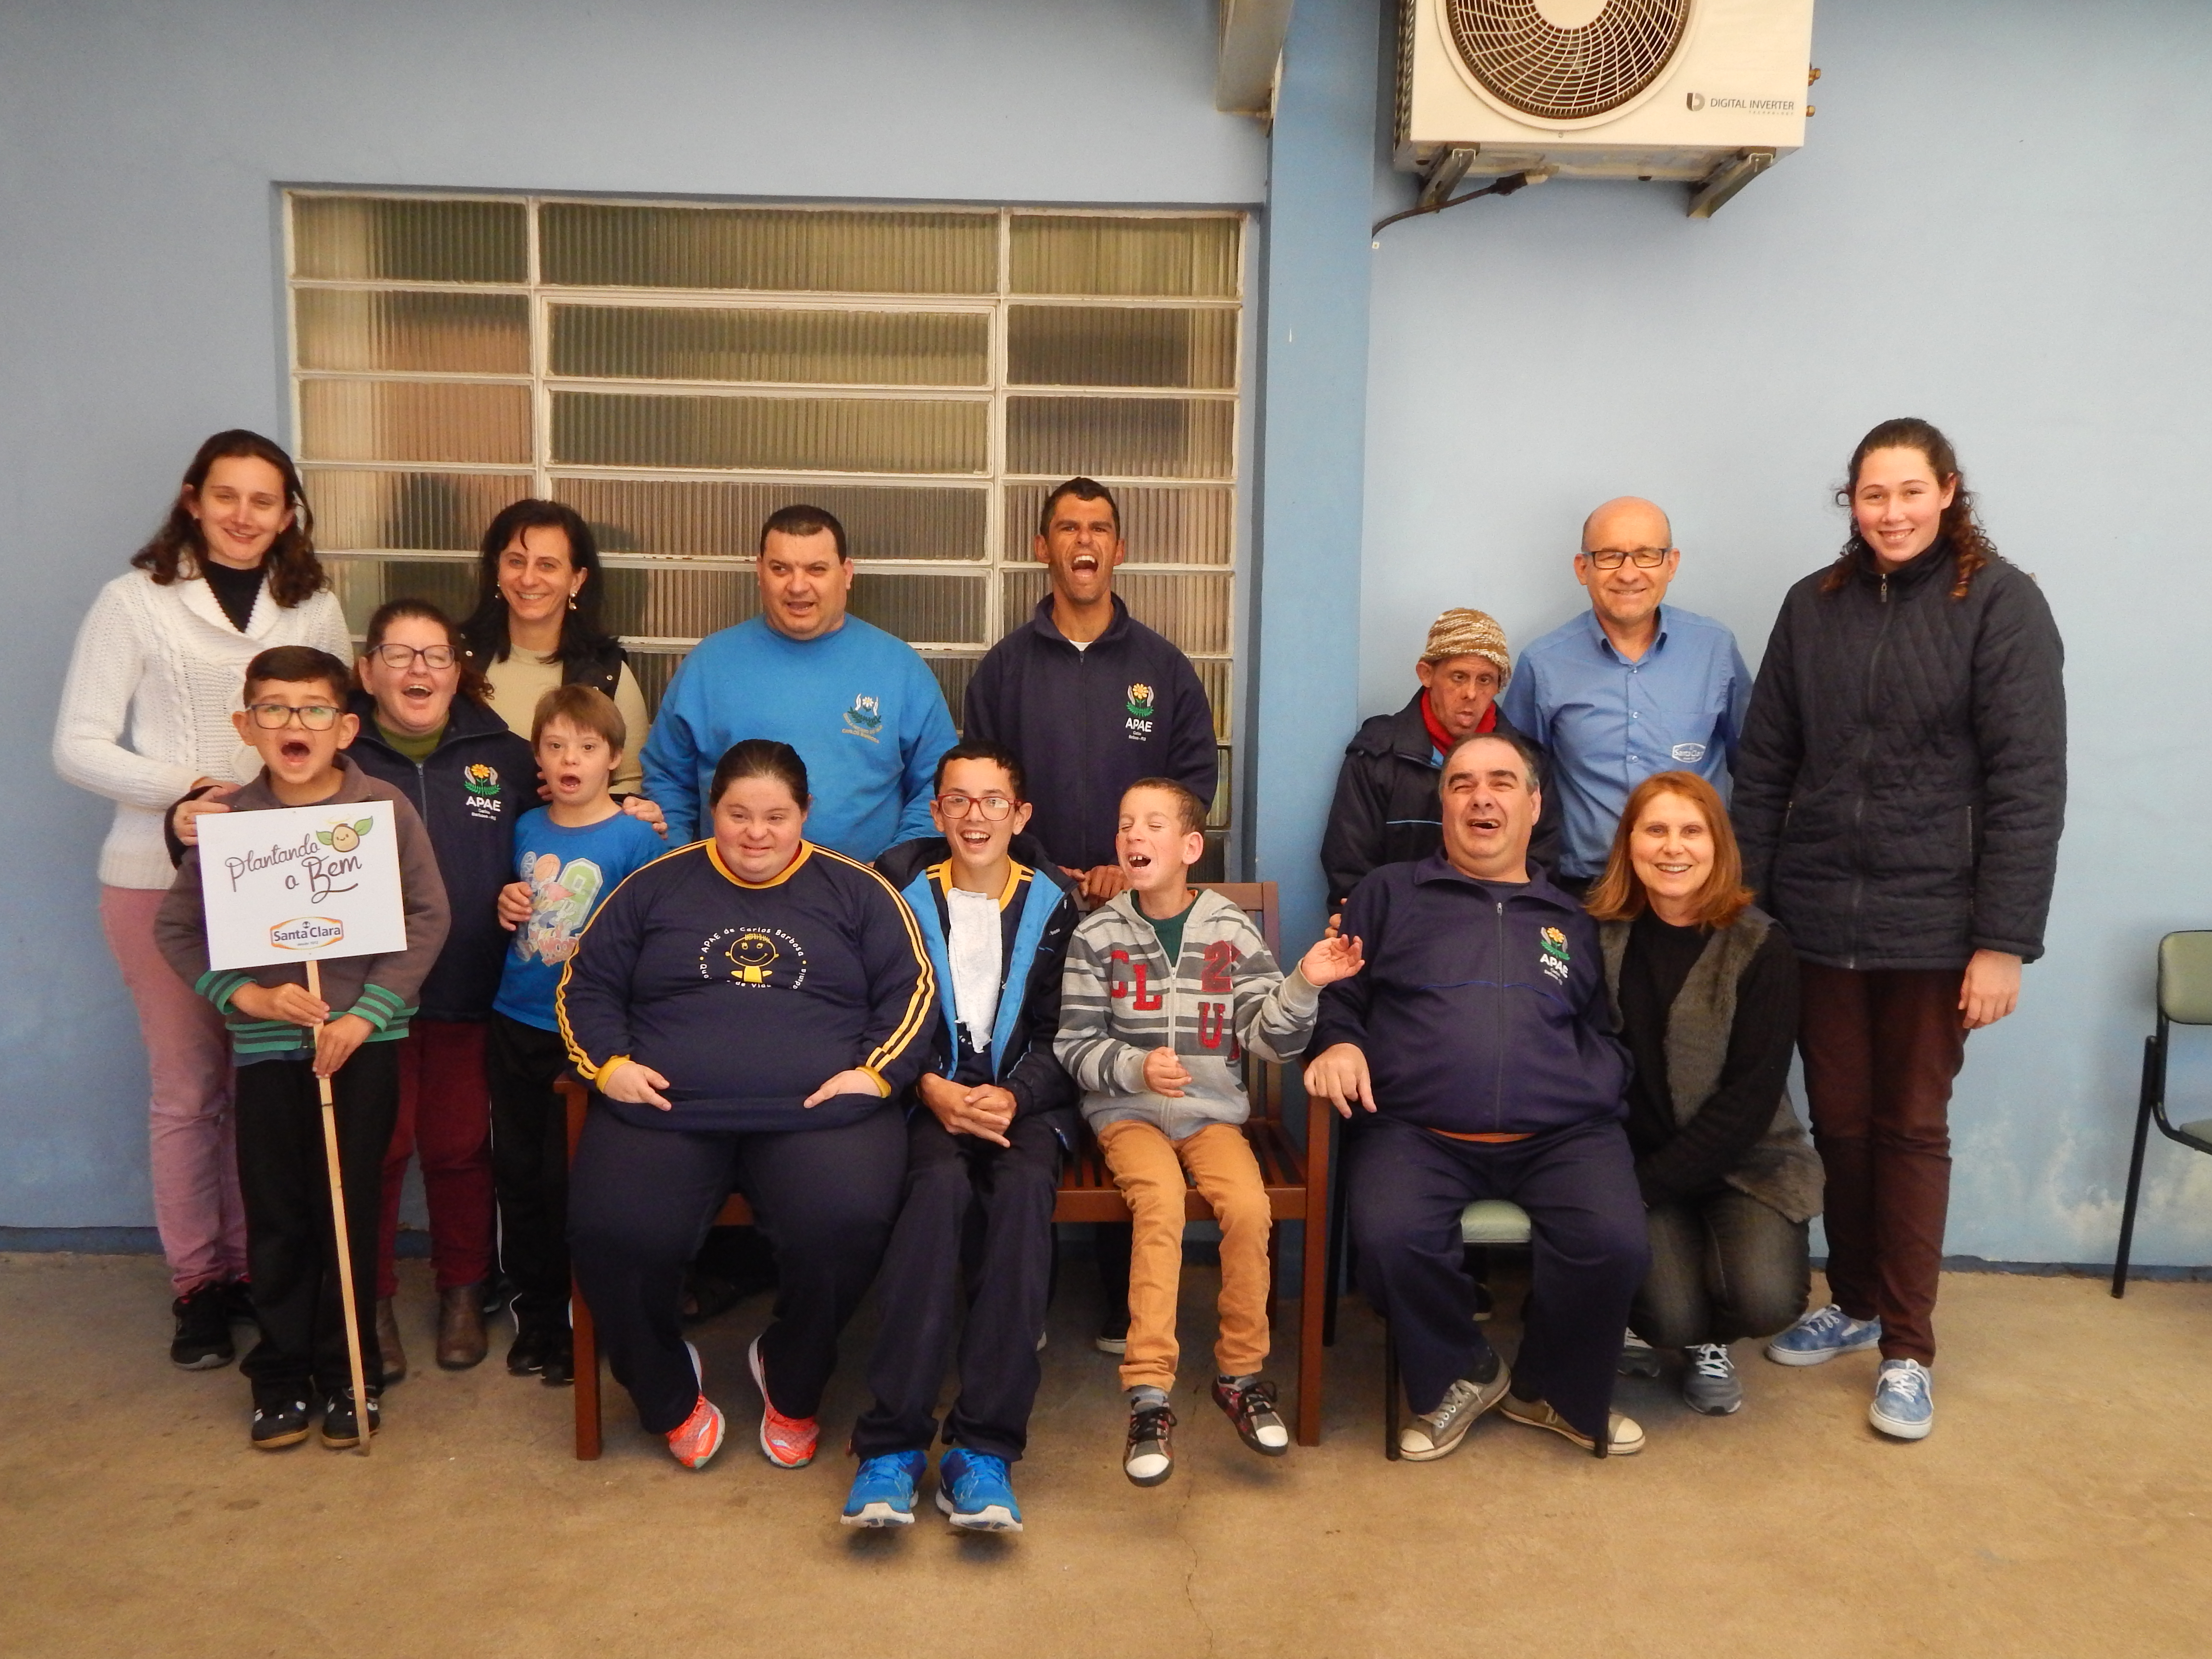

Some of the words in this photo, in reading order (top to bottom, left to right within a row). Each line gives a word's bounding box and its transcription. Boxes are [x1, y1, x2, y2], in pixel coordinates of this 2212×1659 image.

[1710, 98, 1746, 108] DIGITAL
[1750, 100, 1794, 110] INVERTER
[1125, 717, 1153, 732] APAE
[466, 795, 501, 812] APAE
[225, 833, 320, 892] Plantando
[301, 856, 362, 903] Bem
[274, 929, 308, 941] Santa
[310, 926, 341, 938] Clara
[701, 933, 721, 953] APAE
[775, 929, 804, 957] Barbosa
[1540, 953, 1568, 978] APAE
